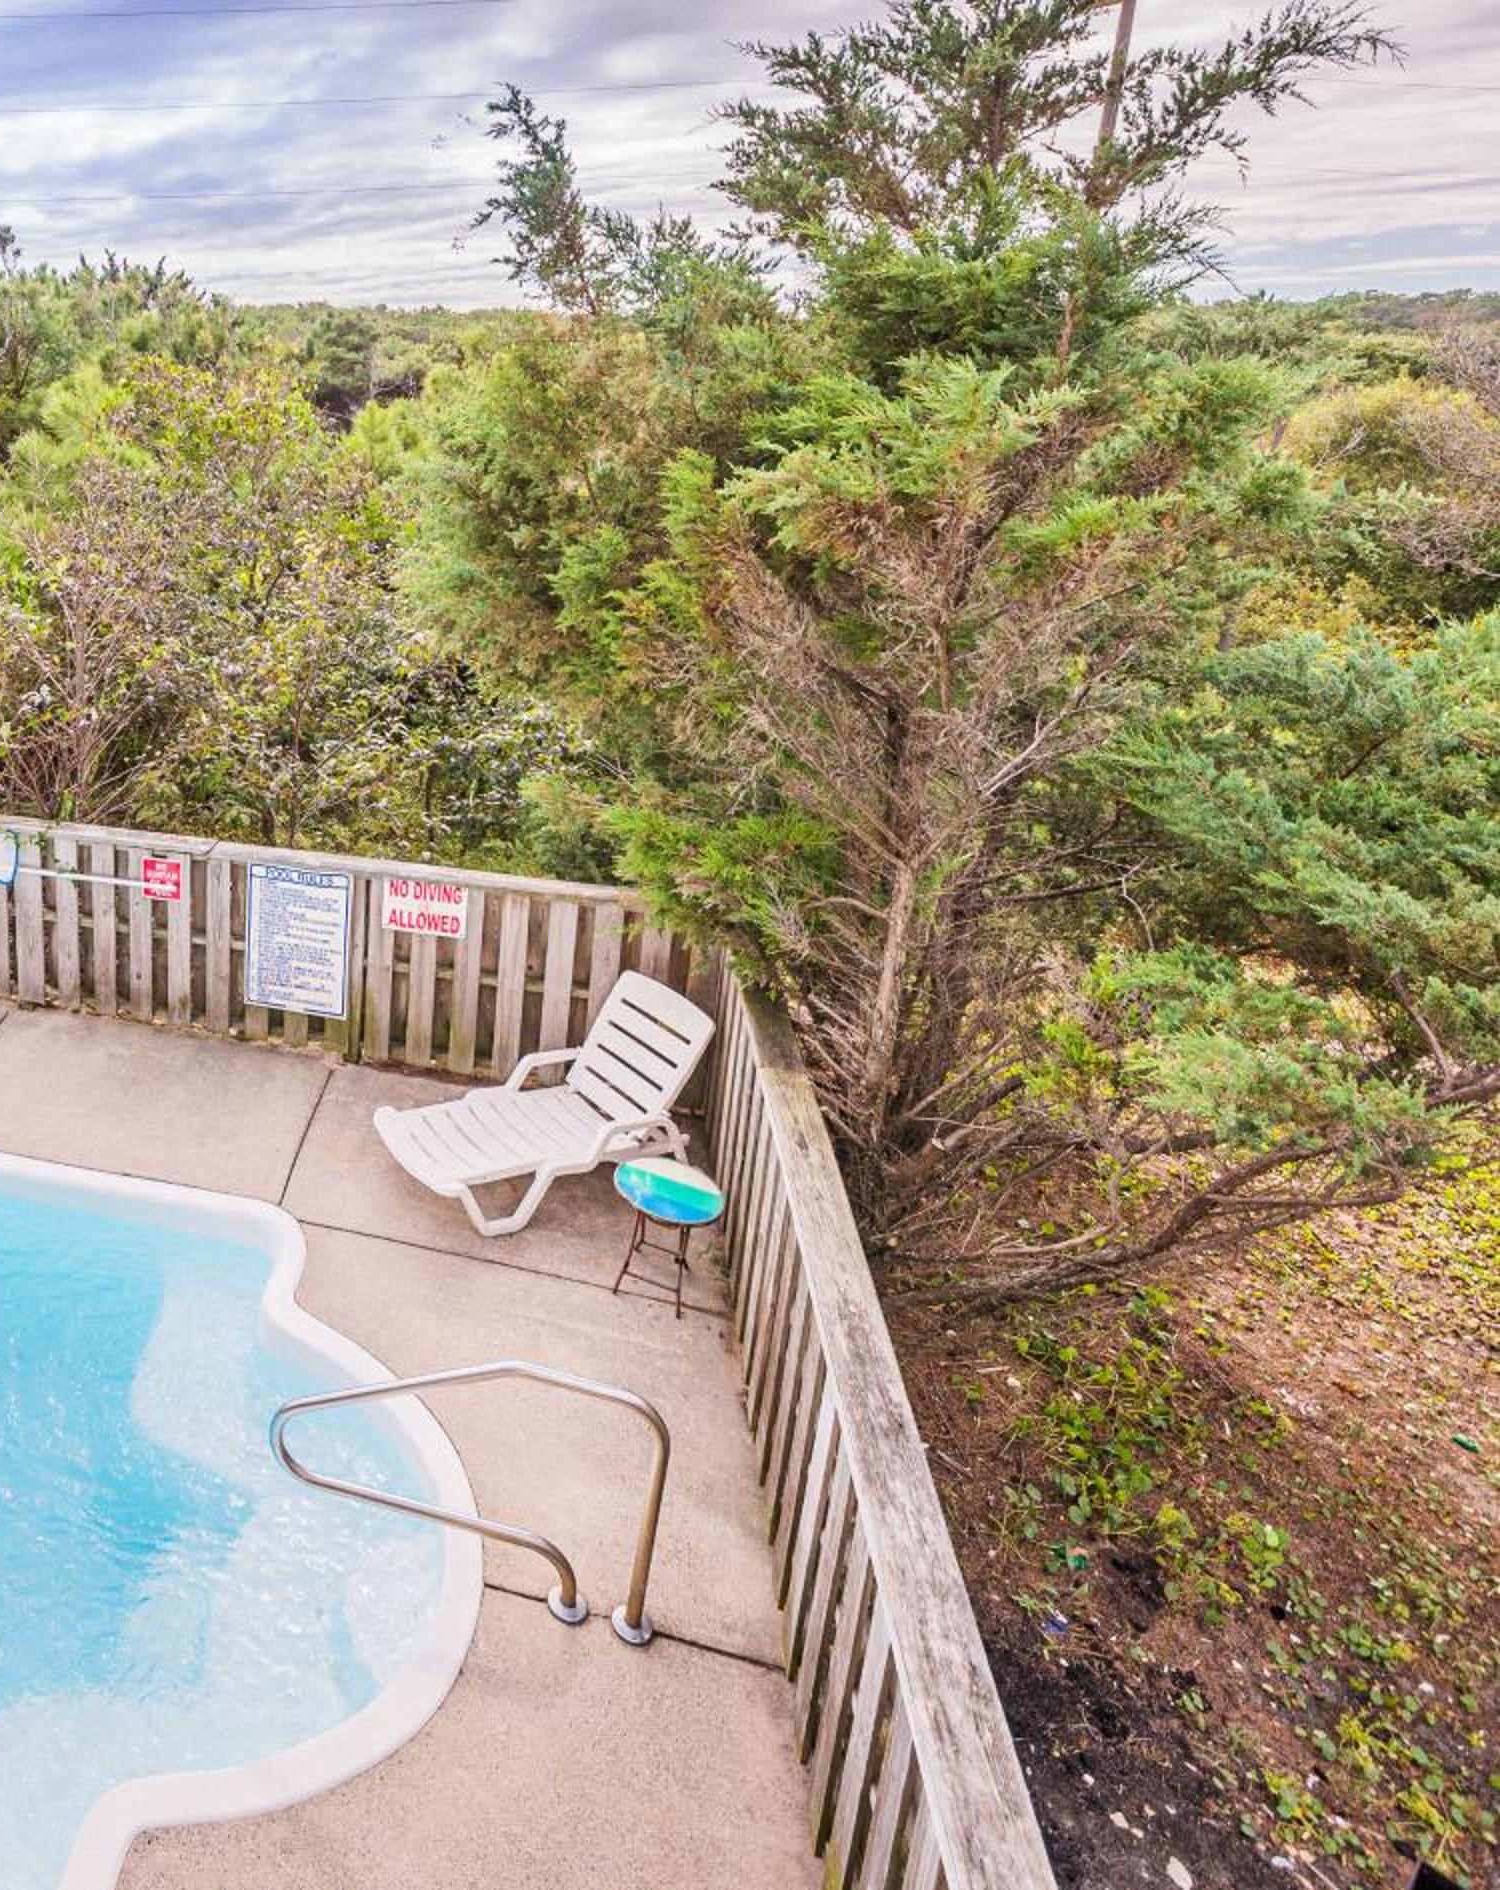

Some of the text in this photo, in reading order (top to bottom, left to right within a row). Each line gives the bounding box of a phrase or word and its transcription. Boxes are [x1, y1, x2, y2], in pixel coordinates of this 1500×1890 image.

[389, 879, 463, 905] NO DIVING
[388, 908, 461, 935] ALLOWED
